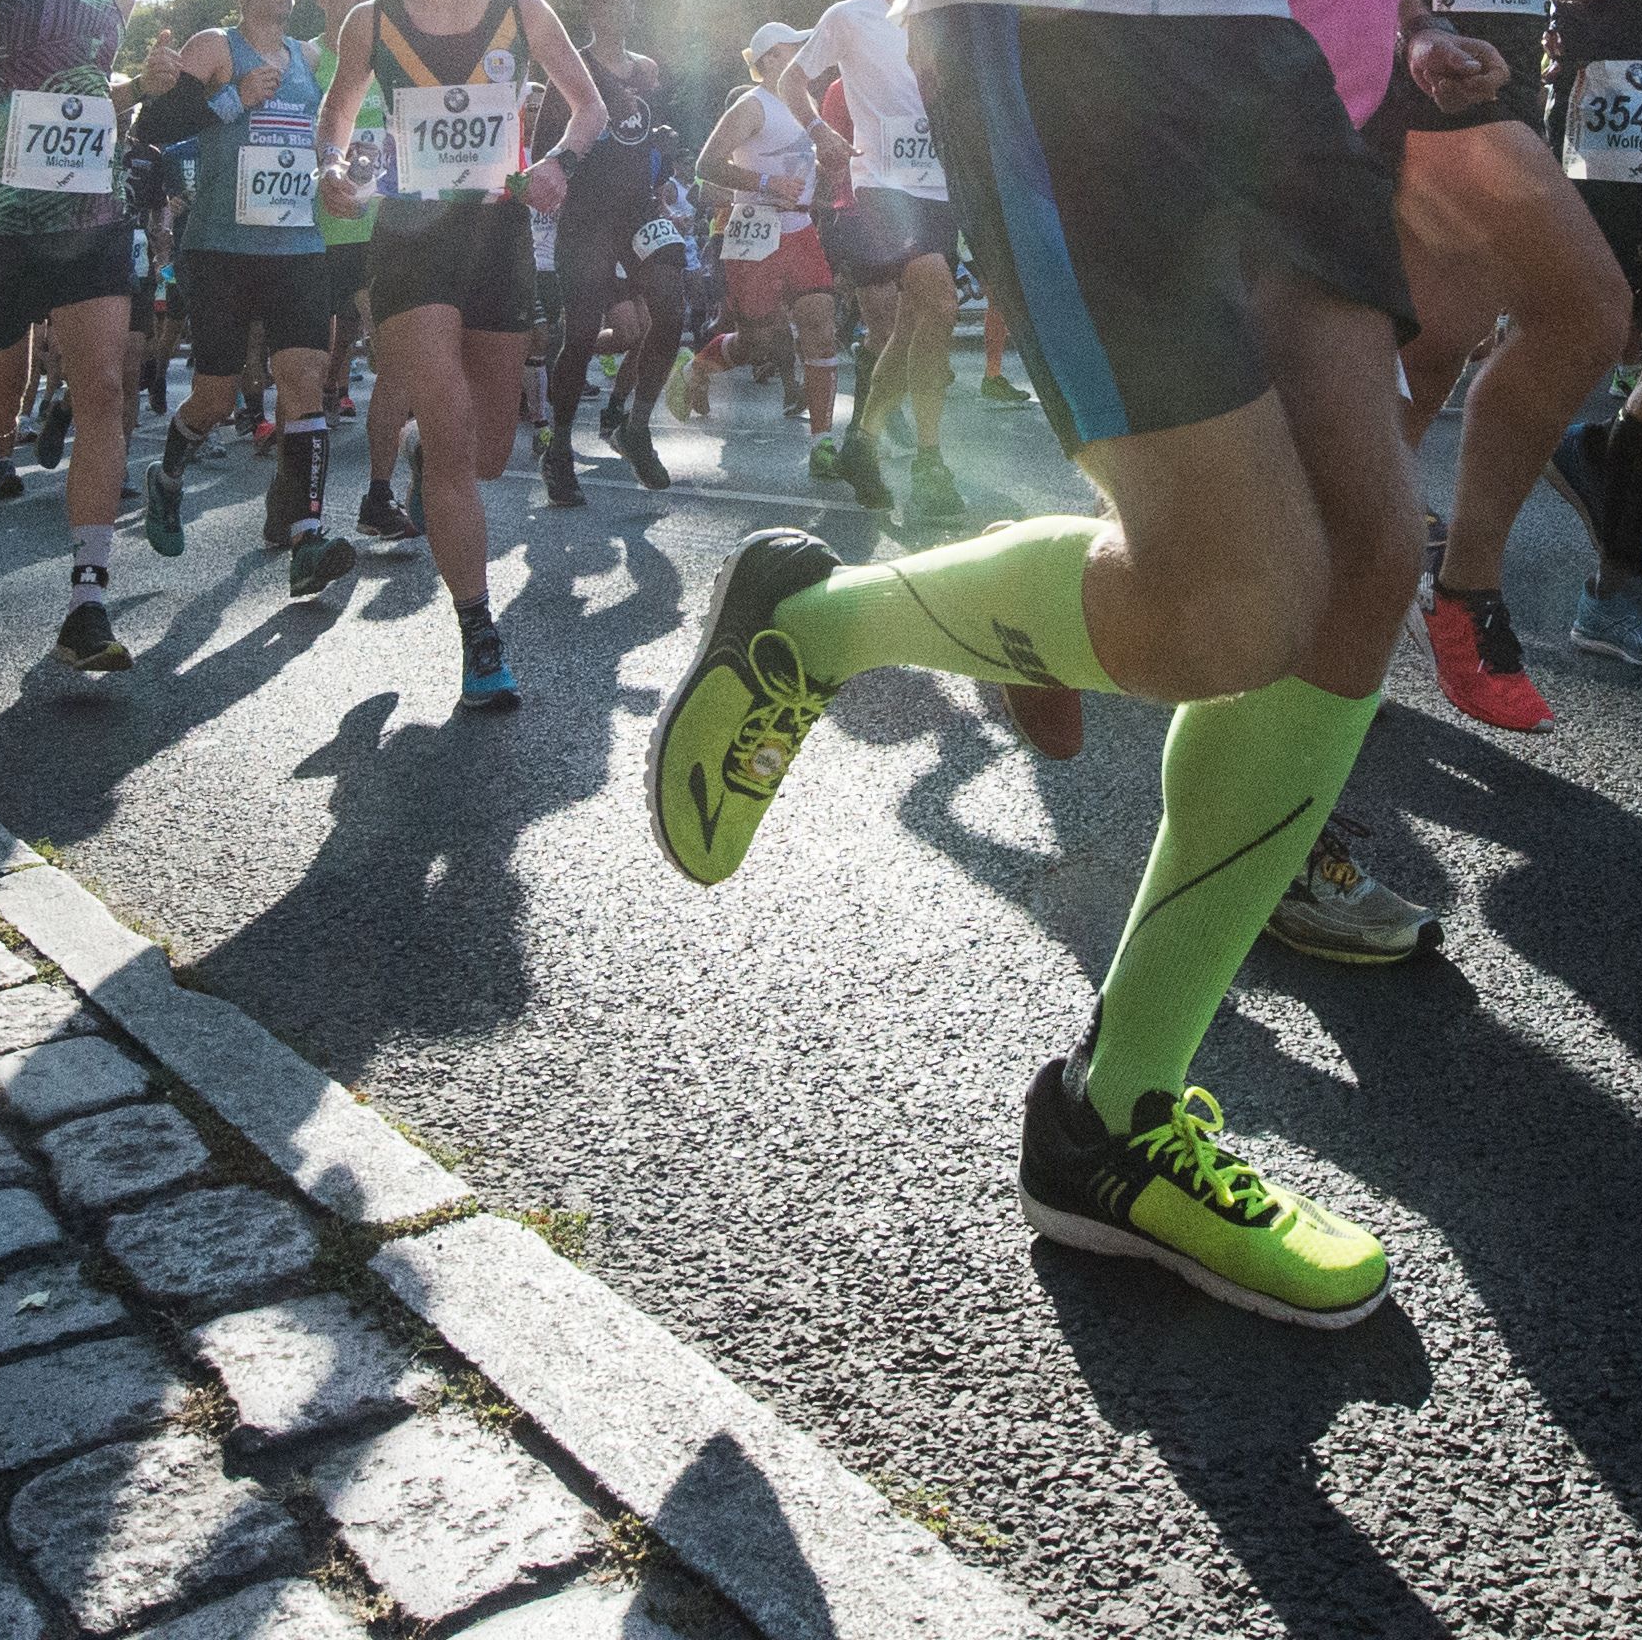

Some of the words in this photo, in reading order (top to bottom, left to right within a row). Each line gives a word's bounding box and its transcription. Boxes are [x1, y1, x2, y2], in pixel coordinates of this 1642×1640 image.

[25, 124, 106, 158] 70574
[413, 115, 504, 152] 16897
[45, 155, 85, 168] Michael
[252, 171, 312, 197] 67012
